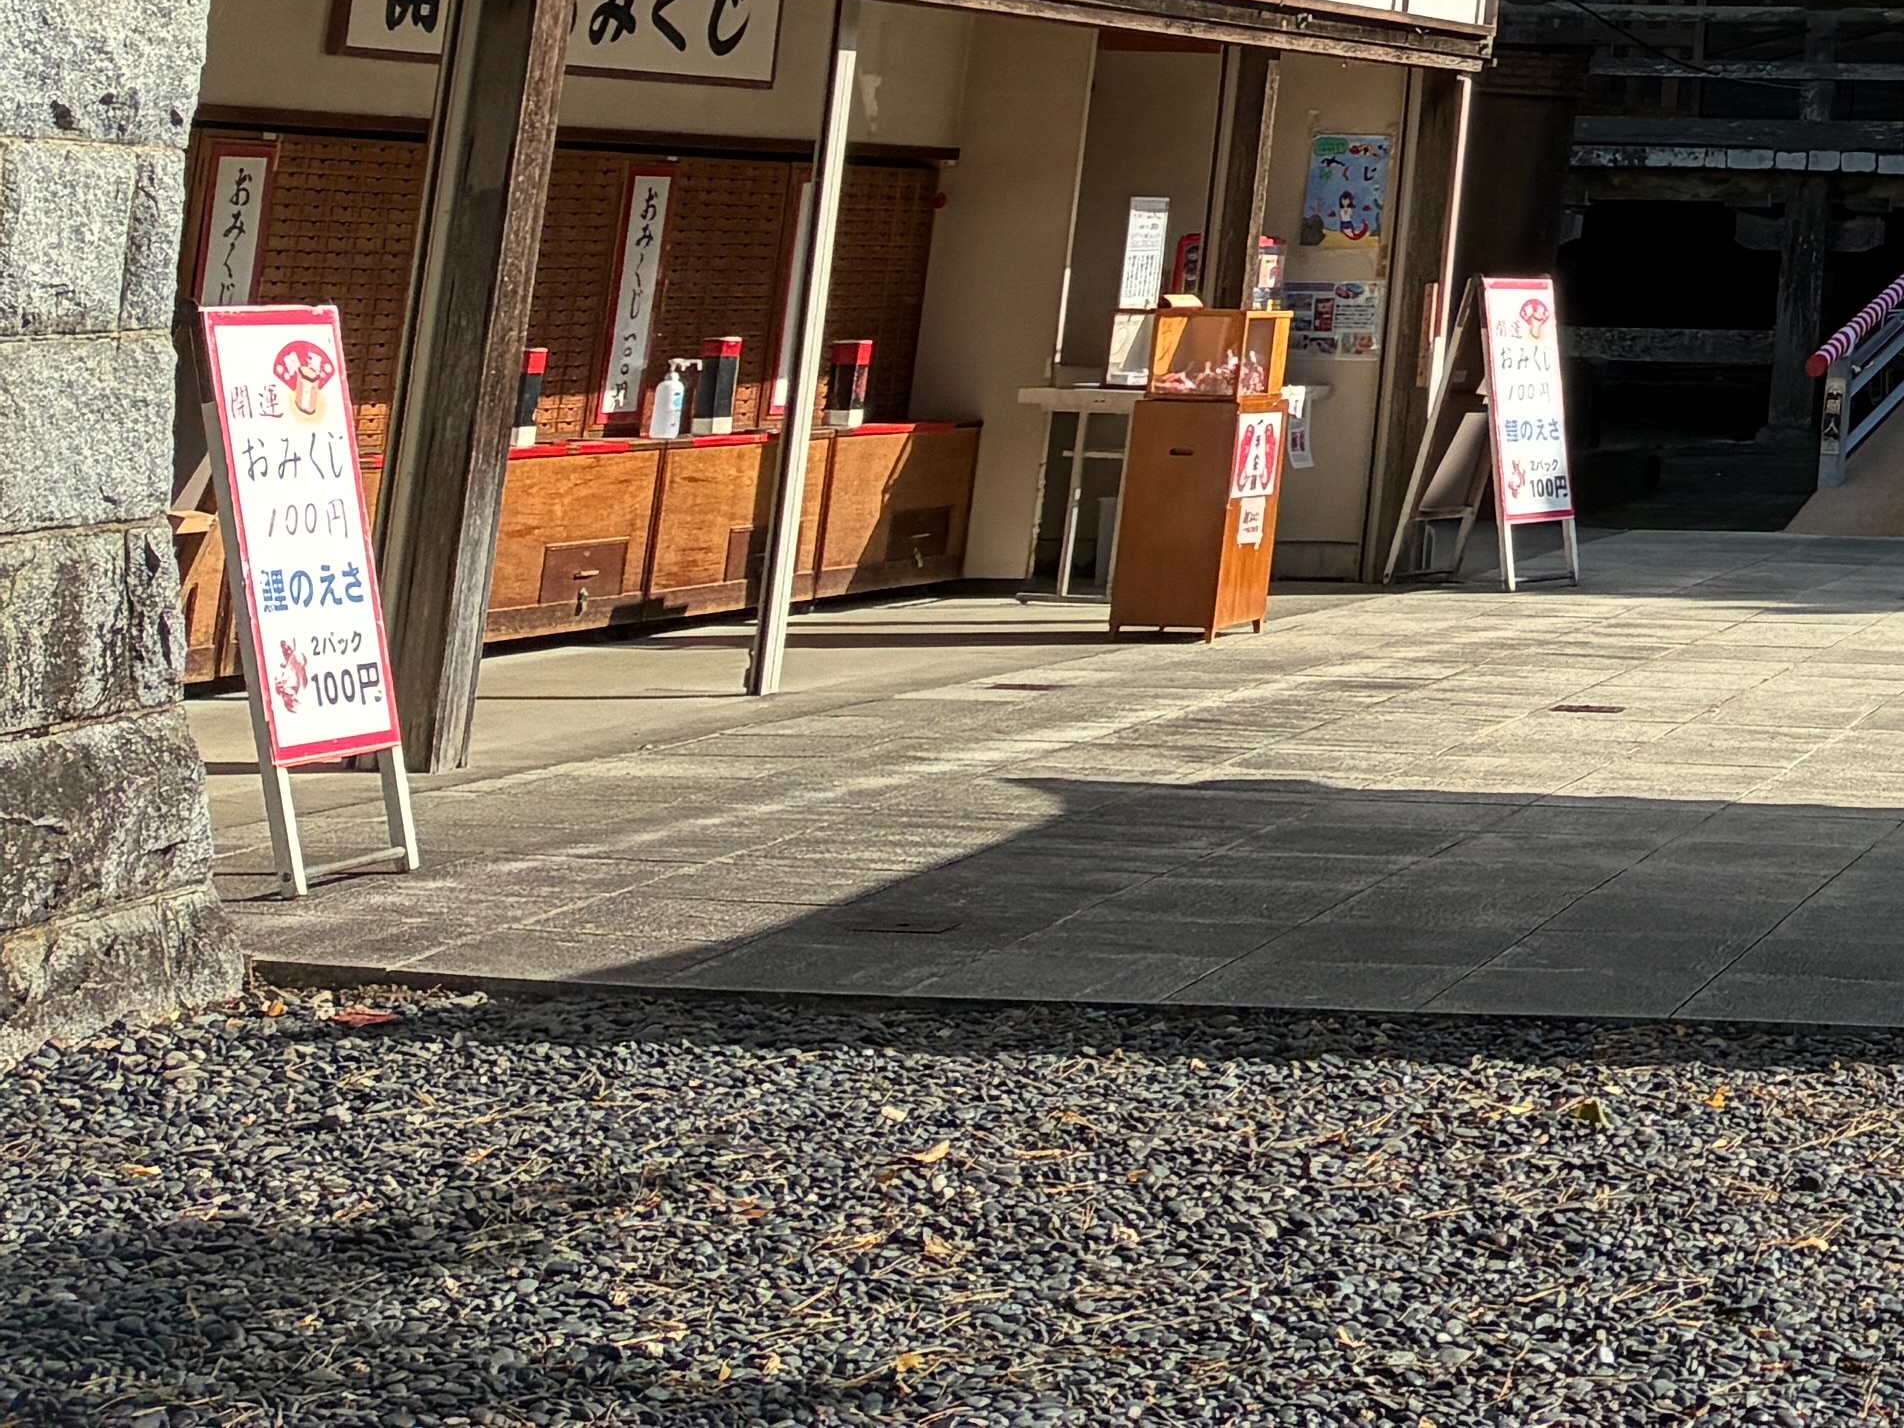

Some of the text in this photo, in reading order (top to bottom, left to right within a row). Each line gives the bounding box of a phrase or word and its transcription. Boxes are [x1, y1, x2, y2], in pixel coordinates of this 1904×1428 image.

[1500, 346, 1551, 372] おみくじ
[230, 384, 284, 420] 開運
[1507, 382, 1551, 403] 100円
[242, 432, 344, 482] おみくじ
[1529, 475, 1568, 499] 100円
[268, 498, 349, 539] 100円
[311, 630, 362, 656] 2パック
[311, 662, 381, 707] 100円
